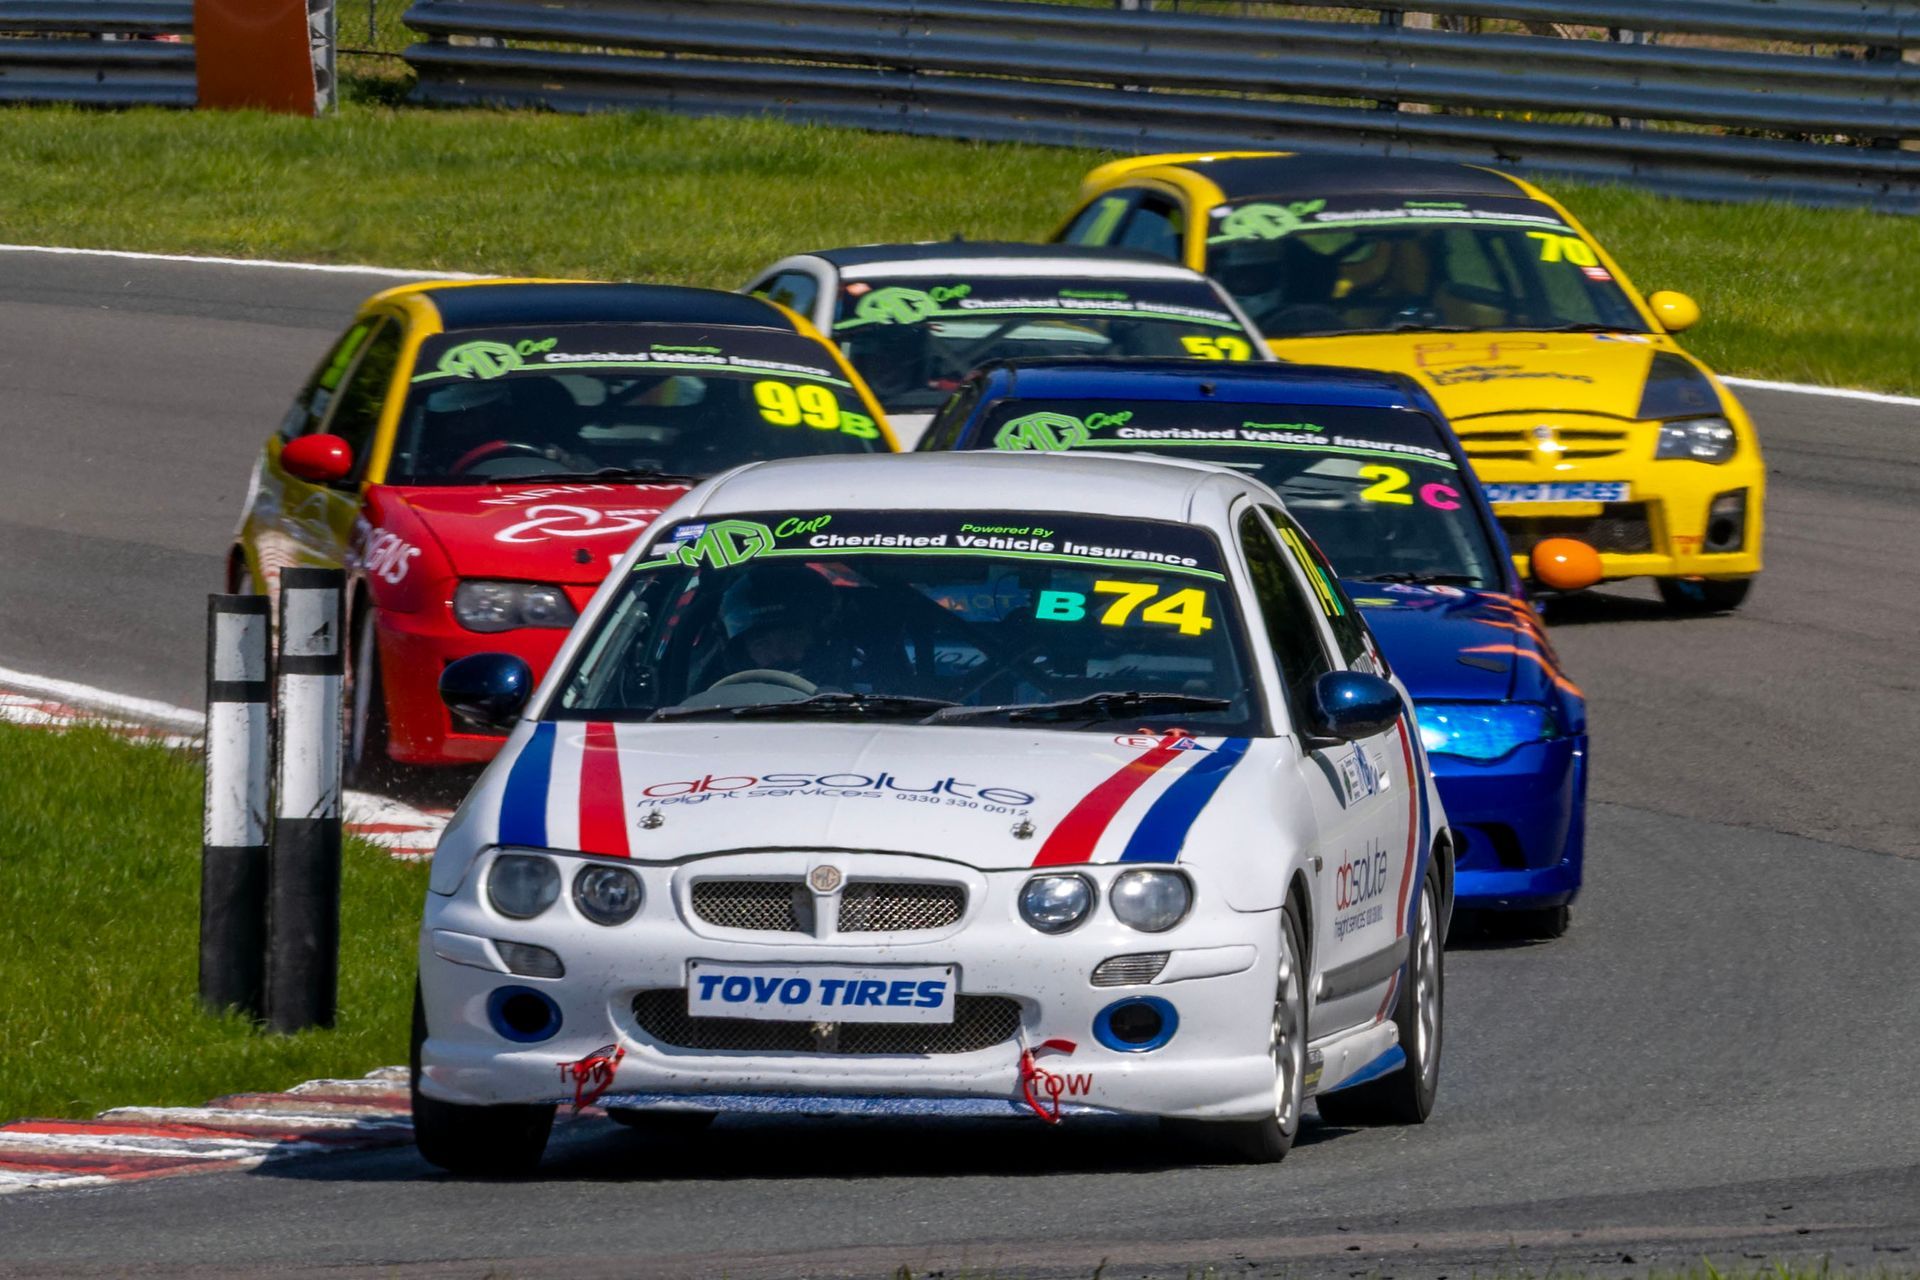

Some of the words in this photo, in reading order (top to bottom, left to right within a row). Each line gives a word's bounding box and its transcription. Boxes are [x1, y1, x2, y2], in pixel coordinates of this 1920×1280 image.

[1526, 232, 1600, 266] 70
[437, 340, 524, 379] MG
[753, 380, 841, 430] 99
[840, 411, 880, 439] B
[994, 412, 1090, 450] MG
[1084, 411, 1133, 430] Cup
[1117, 427, 1236, 439] Cherished
[1239, 429, 1329, 445] Vehicle
[1333, 436, 1451, 461] Insurance
[1358, 464, 1413, 505] 2
[680, 520, 775, 569] MG
[774, 515, 832, 538] Cup
[960, 523, 1029, 536] Powered
[1032, 524, 1054, 538] By
[809, 534, 947, 548] Cherished
[955, 535, 1055, 552] Vehicle
[1063, 542, 1198, 567] Insurance
[1036, 590, 1087, 622] B
[1093, 580, 1212, 636] 74
[636, 790, 739, 808] freight
[747, 787, 883, 799] services
[896, 793, 941, 804] 0330
[945, 797, 979, 810] 330
[983, 803, 1029, 817] 0012
[643, 772, 1035, 806] absolute
[1336, 836, 1388, 911] absolute
[697, 975, 812, 1005] TOYO
[819, 979, 947, 1008] TIRES
[1031, 1072, 1093, 1096] TOW
